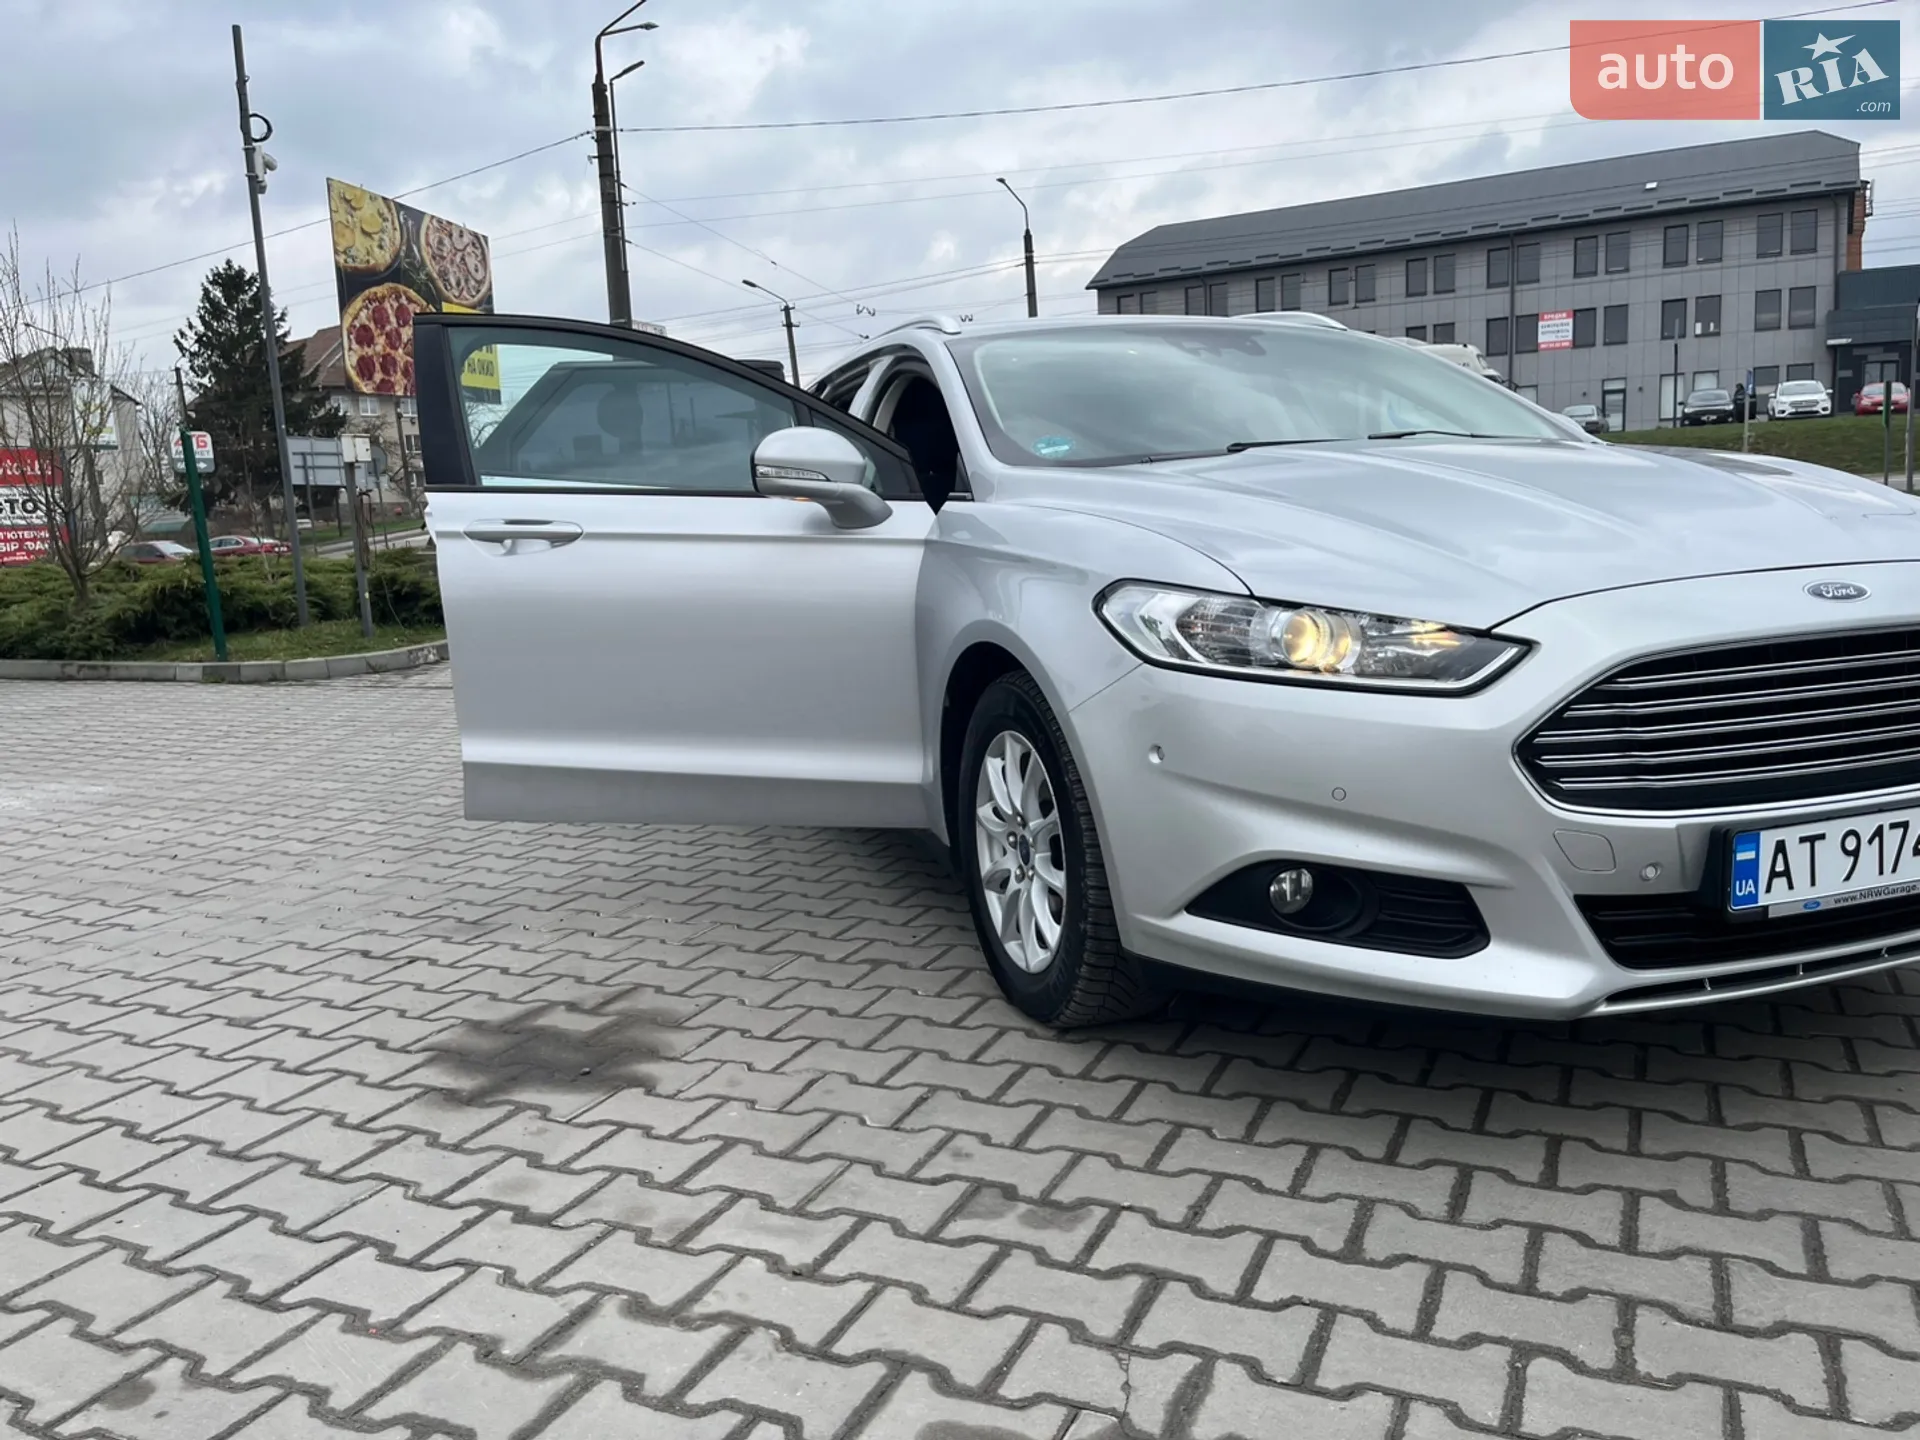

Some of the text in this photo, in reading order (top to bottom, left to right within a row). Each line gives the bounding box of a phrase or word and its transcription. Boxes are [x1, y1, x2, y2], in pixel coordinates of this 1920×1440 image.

[0, 499, 38, 514] ТО
[1821, 583, 1858, 598] Ford
[1764, 832, 1827, 894] AT
[1735, 878, 1756, 896] UA
